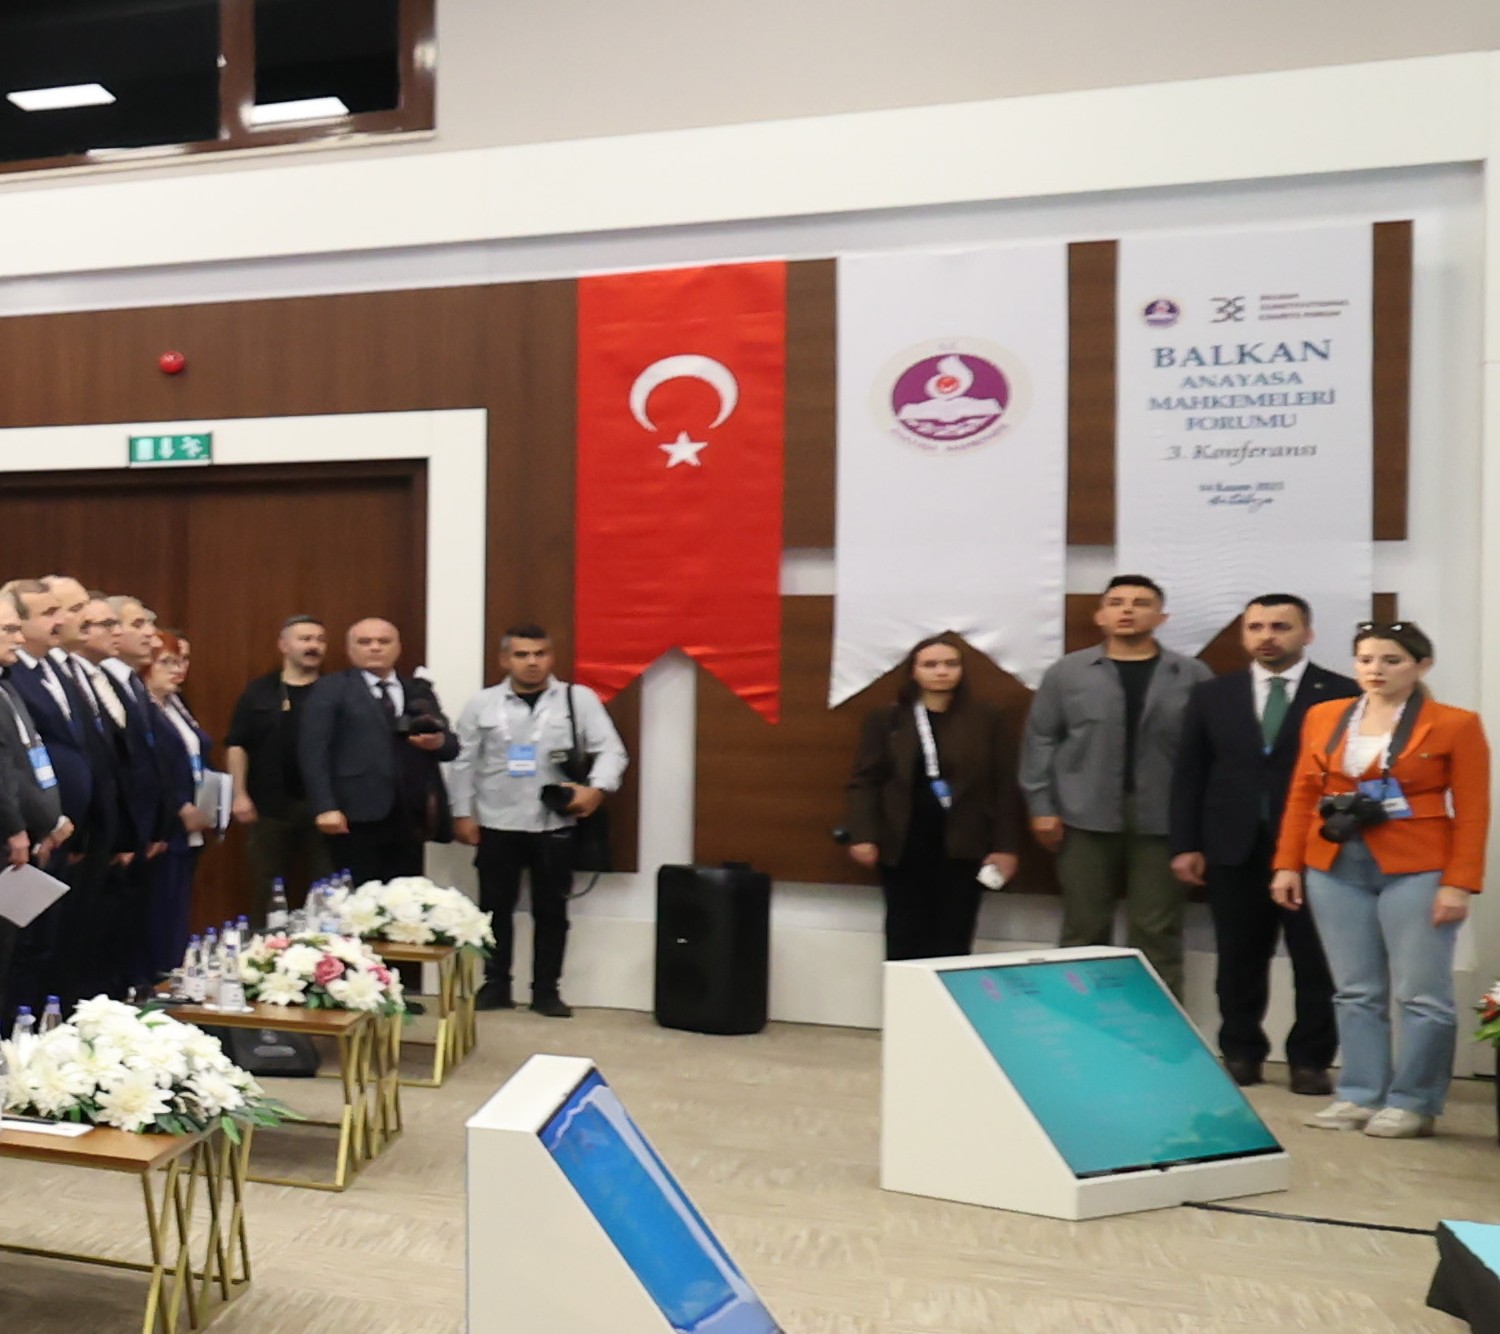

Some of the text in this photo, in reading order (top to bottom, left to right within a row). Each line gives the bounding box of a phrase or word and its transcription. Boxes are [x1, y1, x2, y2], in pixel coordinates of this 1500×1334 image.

[1152, 339, 1332, 368] BALKAN
[1181, 371, 1303, 388] ANAYASA
[1148, 388, 1336, 410] MAHKEMELERİ
[1186, 414, 1297, 431] FORUMU
